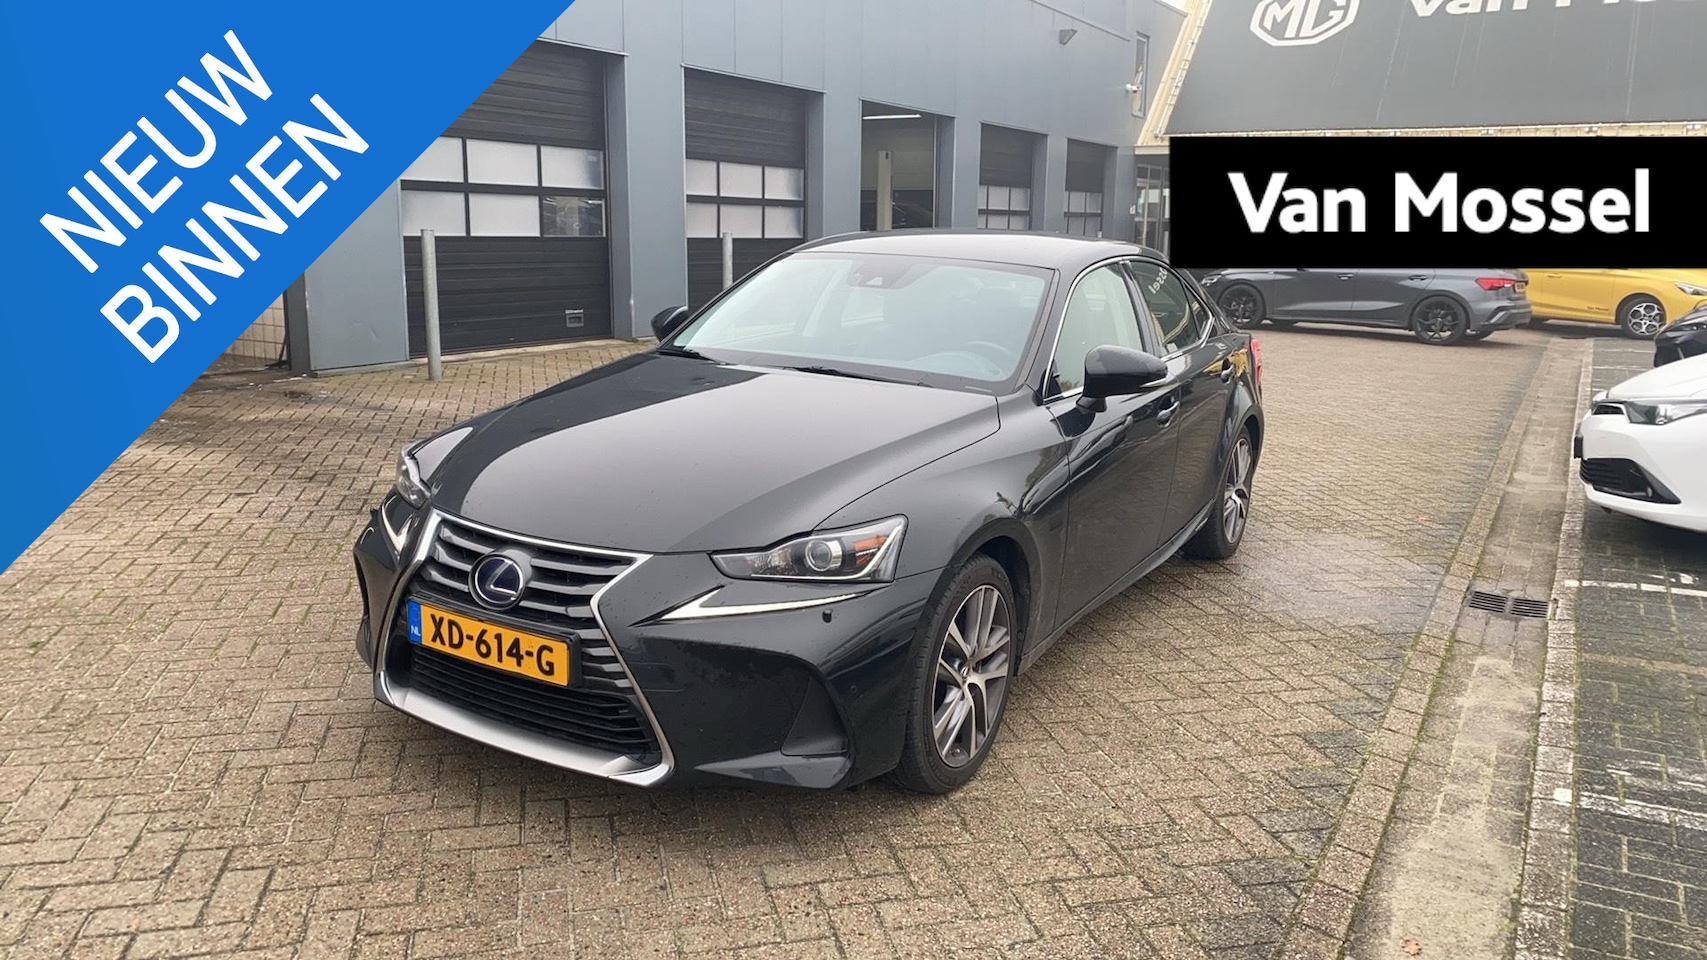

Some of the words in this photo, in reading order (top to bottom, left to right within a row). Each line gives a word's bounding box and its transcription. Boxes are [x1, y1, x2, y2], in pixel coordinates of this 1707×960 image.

[1262, 0, 1346, 39] MG
[410, 625, 421, 637] NL
[430, 613, 555, 676] XD-614-G
